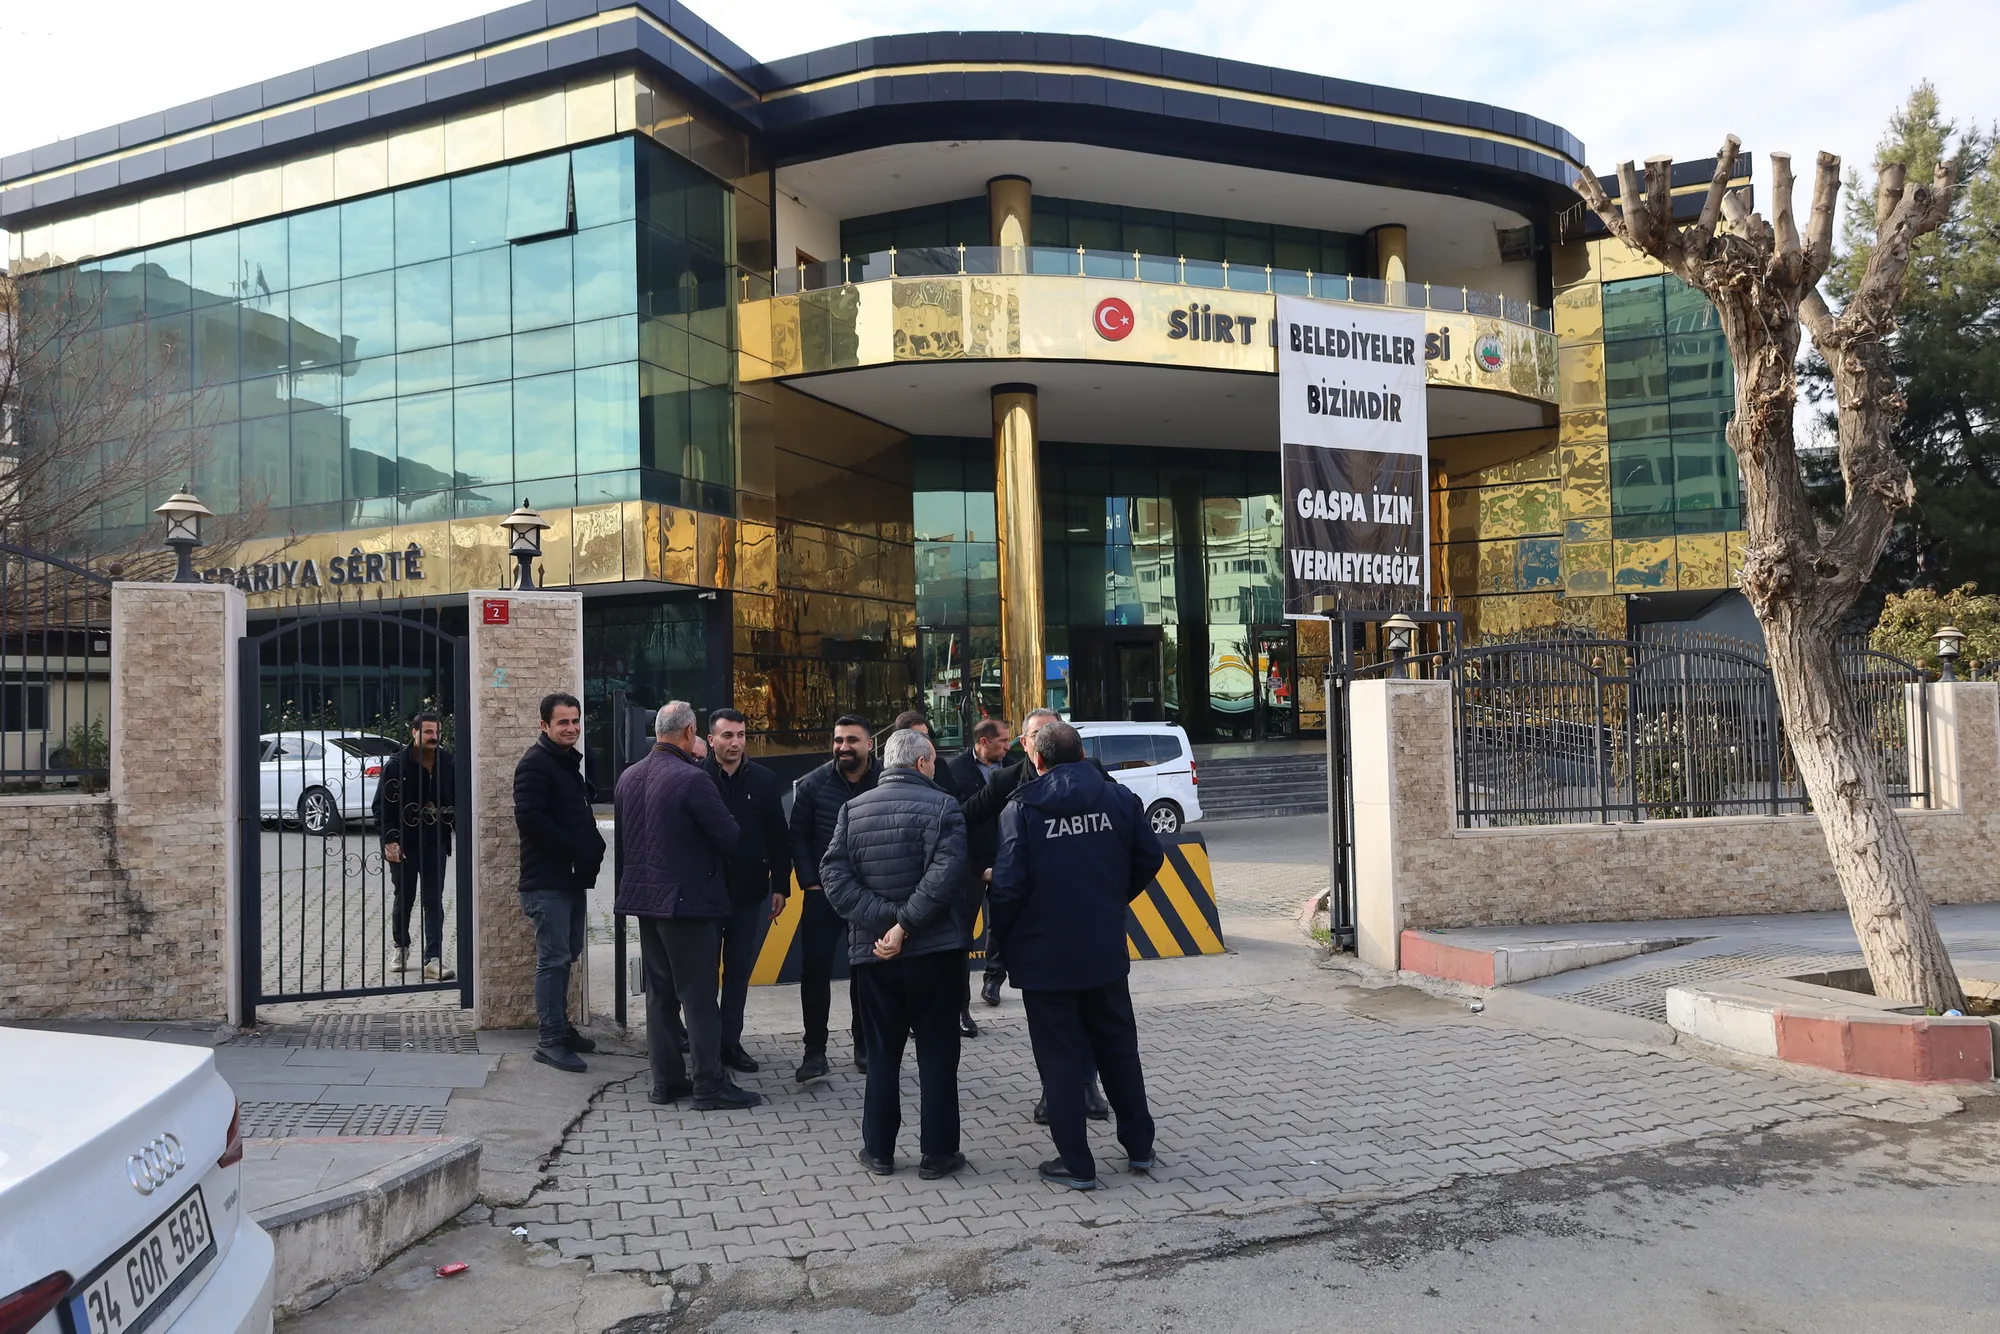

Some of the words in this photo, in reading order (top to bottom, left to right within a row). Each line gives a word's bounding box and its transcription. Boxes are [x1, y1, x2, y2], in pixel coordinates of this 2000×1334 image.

[1167, 303, 1257, 345] SİİRT
[1290, 322, 1416, 366] BELEDİYELER
[1307, 377, 1402, 423] BİZİMDİR
[1297, 488, 1367, 523] GASPA
[1373, 485, 1413, 525] İZİN
[329, 542, 425, 585] SÊRTÊ
[1291, 546, 1420, 585] VERMEYECEĞİZ
[493, 608, 500, 618] 2
[491, 667, 509, 688] 2
[1044, 812, 1113, 839] ZABITA
[89, 1280, 122, 1334] 34
[127, 1235, 168, 1308] GOR
[168, 1199, 205, 1265] 583
